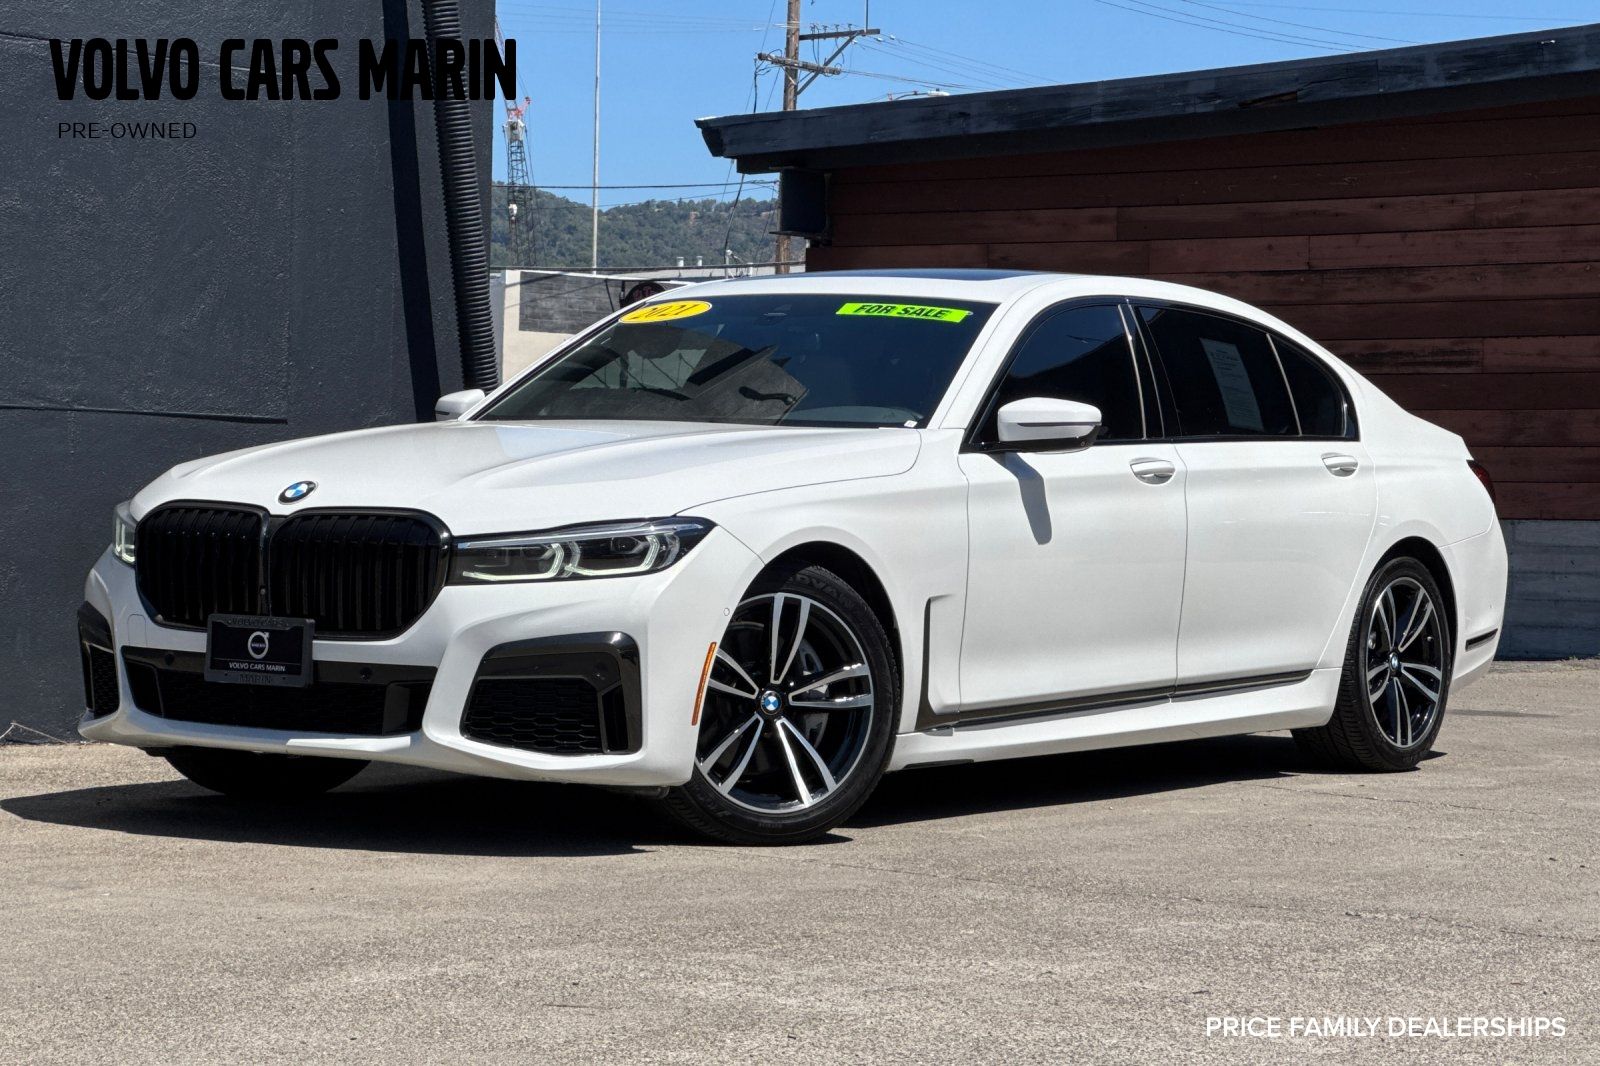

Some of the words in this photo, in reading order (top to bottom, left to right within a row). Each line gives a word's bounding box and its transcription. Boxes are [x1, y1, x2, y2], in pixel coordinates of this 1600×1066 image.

[628, 304, 701, 320] 2021
[853, 304, 896, 315] FOR
[897, 306, 951, 318] SALE
[229, 661, 249, 669] VOLVO
[249, 662, 265, 671] CARS
[266, 663, 286, 672] MARIN
